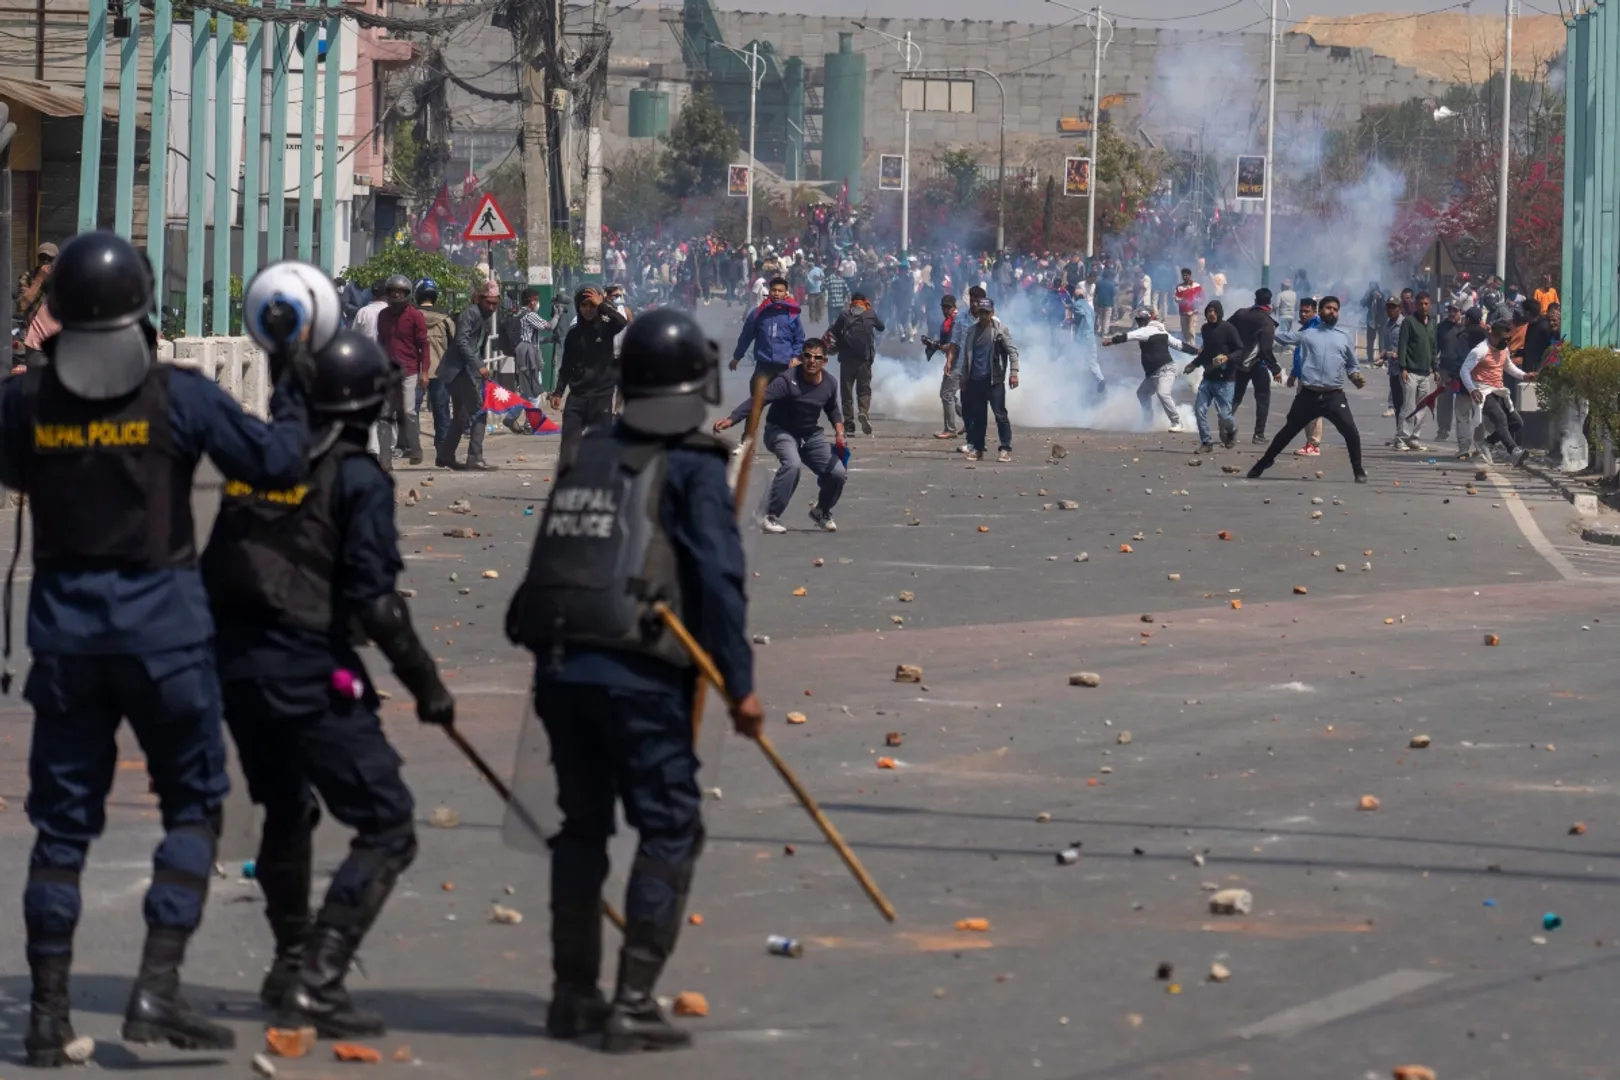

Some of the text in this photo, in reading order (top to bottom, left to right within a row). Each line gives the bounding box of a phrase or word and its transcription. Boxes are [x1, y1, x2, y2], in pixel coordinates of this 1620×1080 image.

[35, 421, 149, 447] NEPAL POLICE
[553, 488, 616, 512] NEPAL
[546, 513, 614, 537] POLICE
